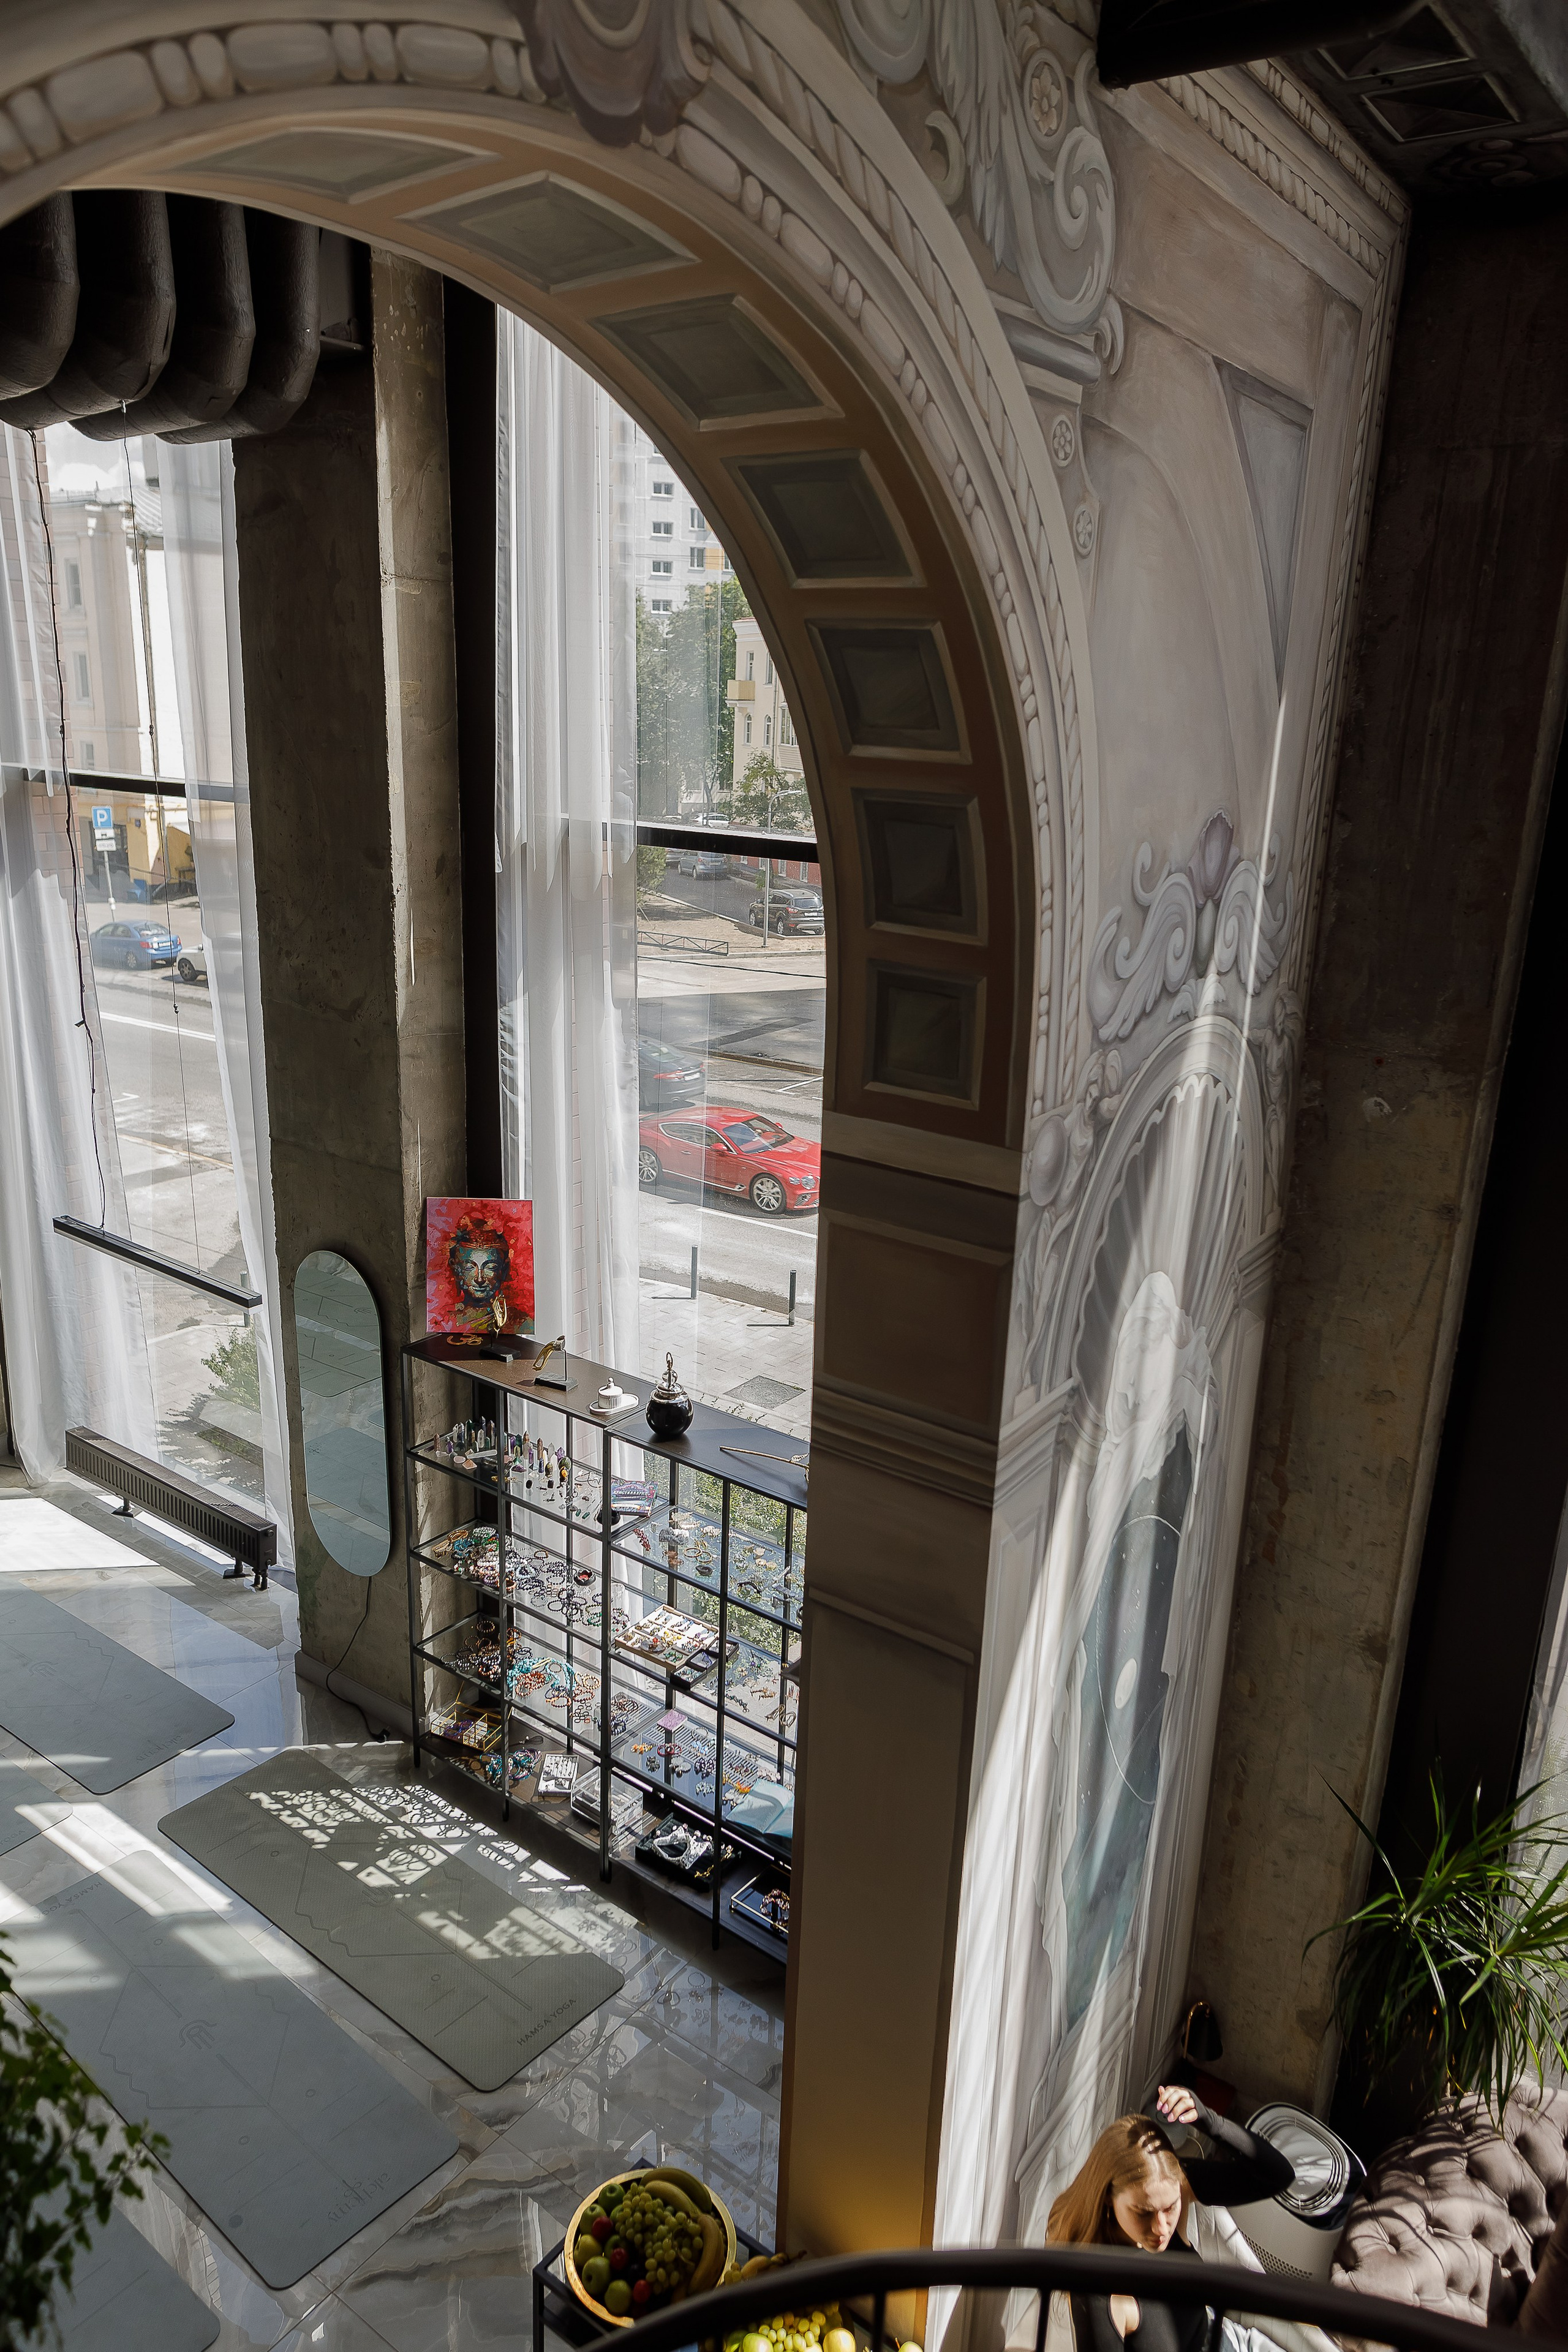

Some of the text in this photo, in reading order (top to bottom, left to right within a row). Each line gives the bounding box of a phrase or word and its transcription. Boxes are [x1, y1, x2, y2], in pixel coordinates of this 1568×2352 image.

[97, 810, 108, 826] P
[34, 1882, 102, 1918] HAMSA YOGA
[516, 2000, 576, 2045] HAMSA YOGA
